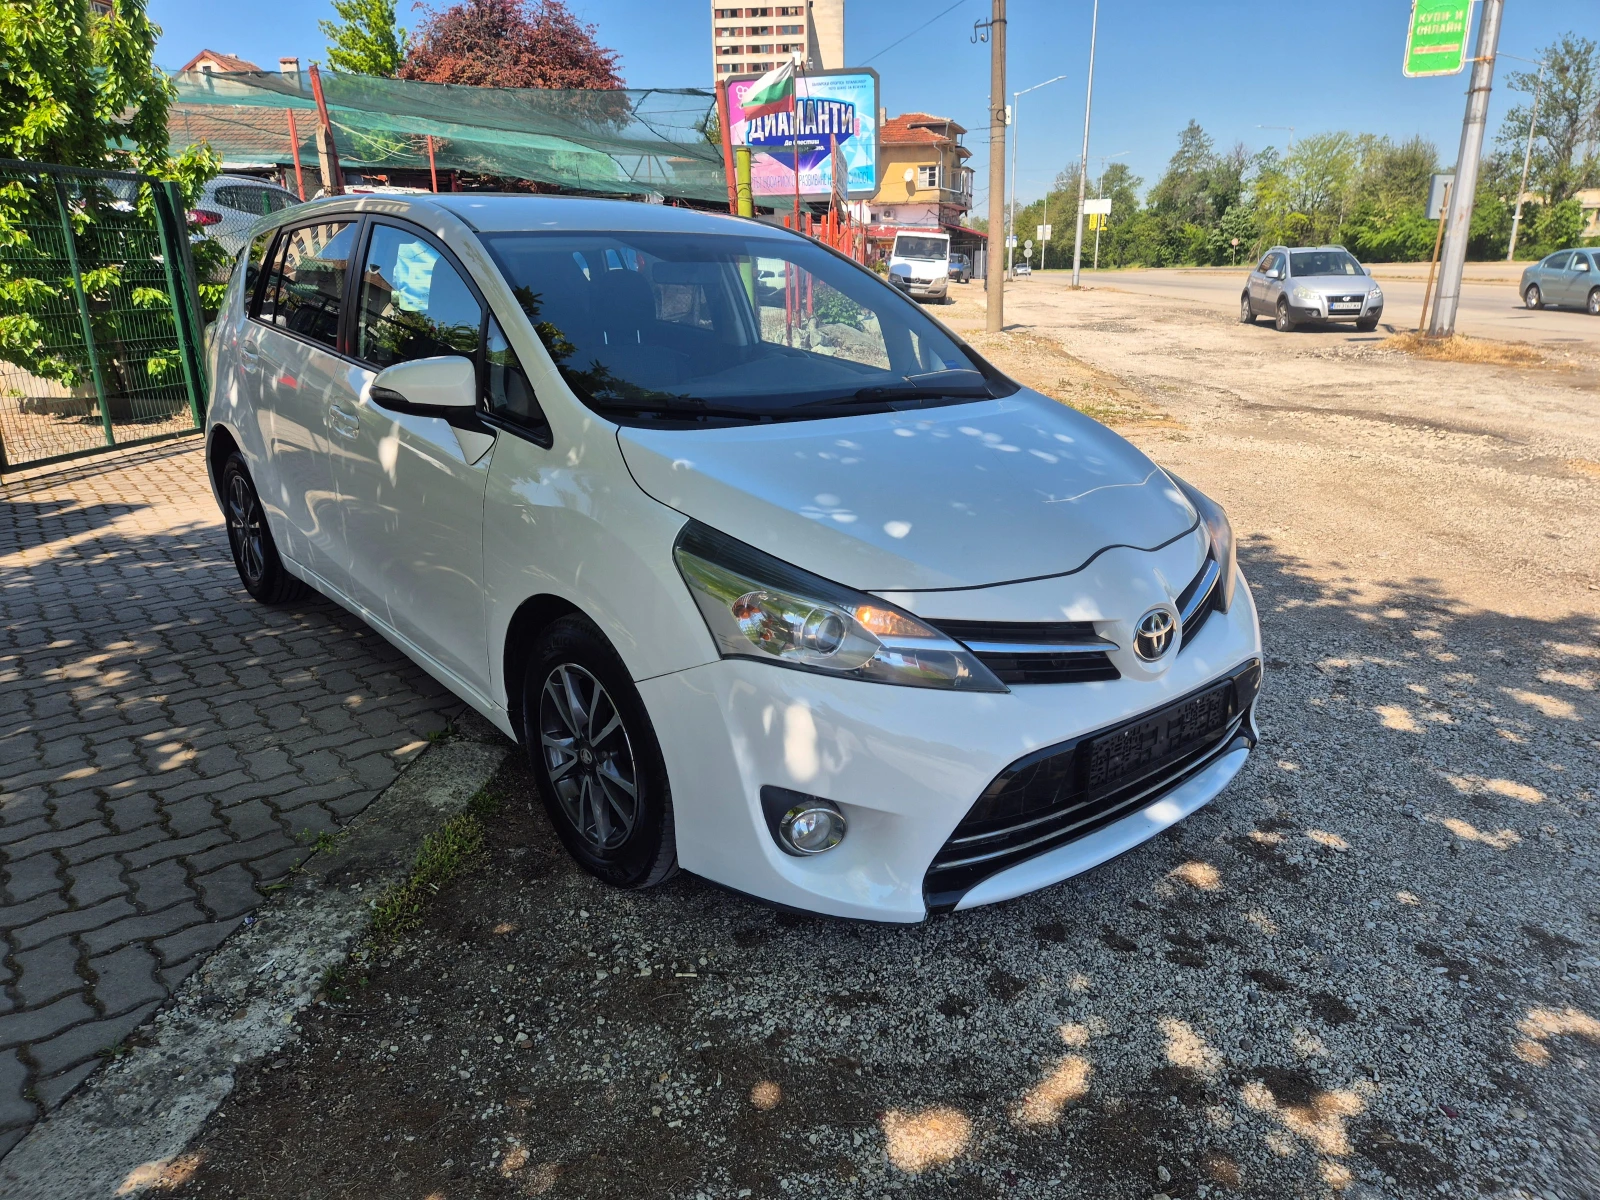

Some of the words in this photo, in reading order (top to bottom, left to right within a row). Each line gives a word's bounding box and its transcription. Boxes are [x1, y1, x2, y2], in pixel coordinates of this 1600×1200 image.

[1418, 11, 1450, 23] КУПИ
[1416, 22, 1462, 35] ОНЛАЙН
[749, 100, 854, 142] ДИАМАНТИ
